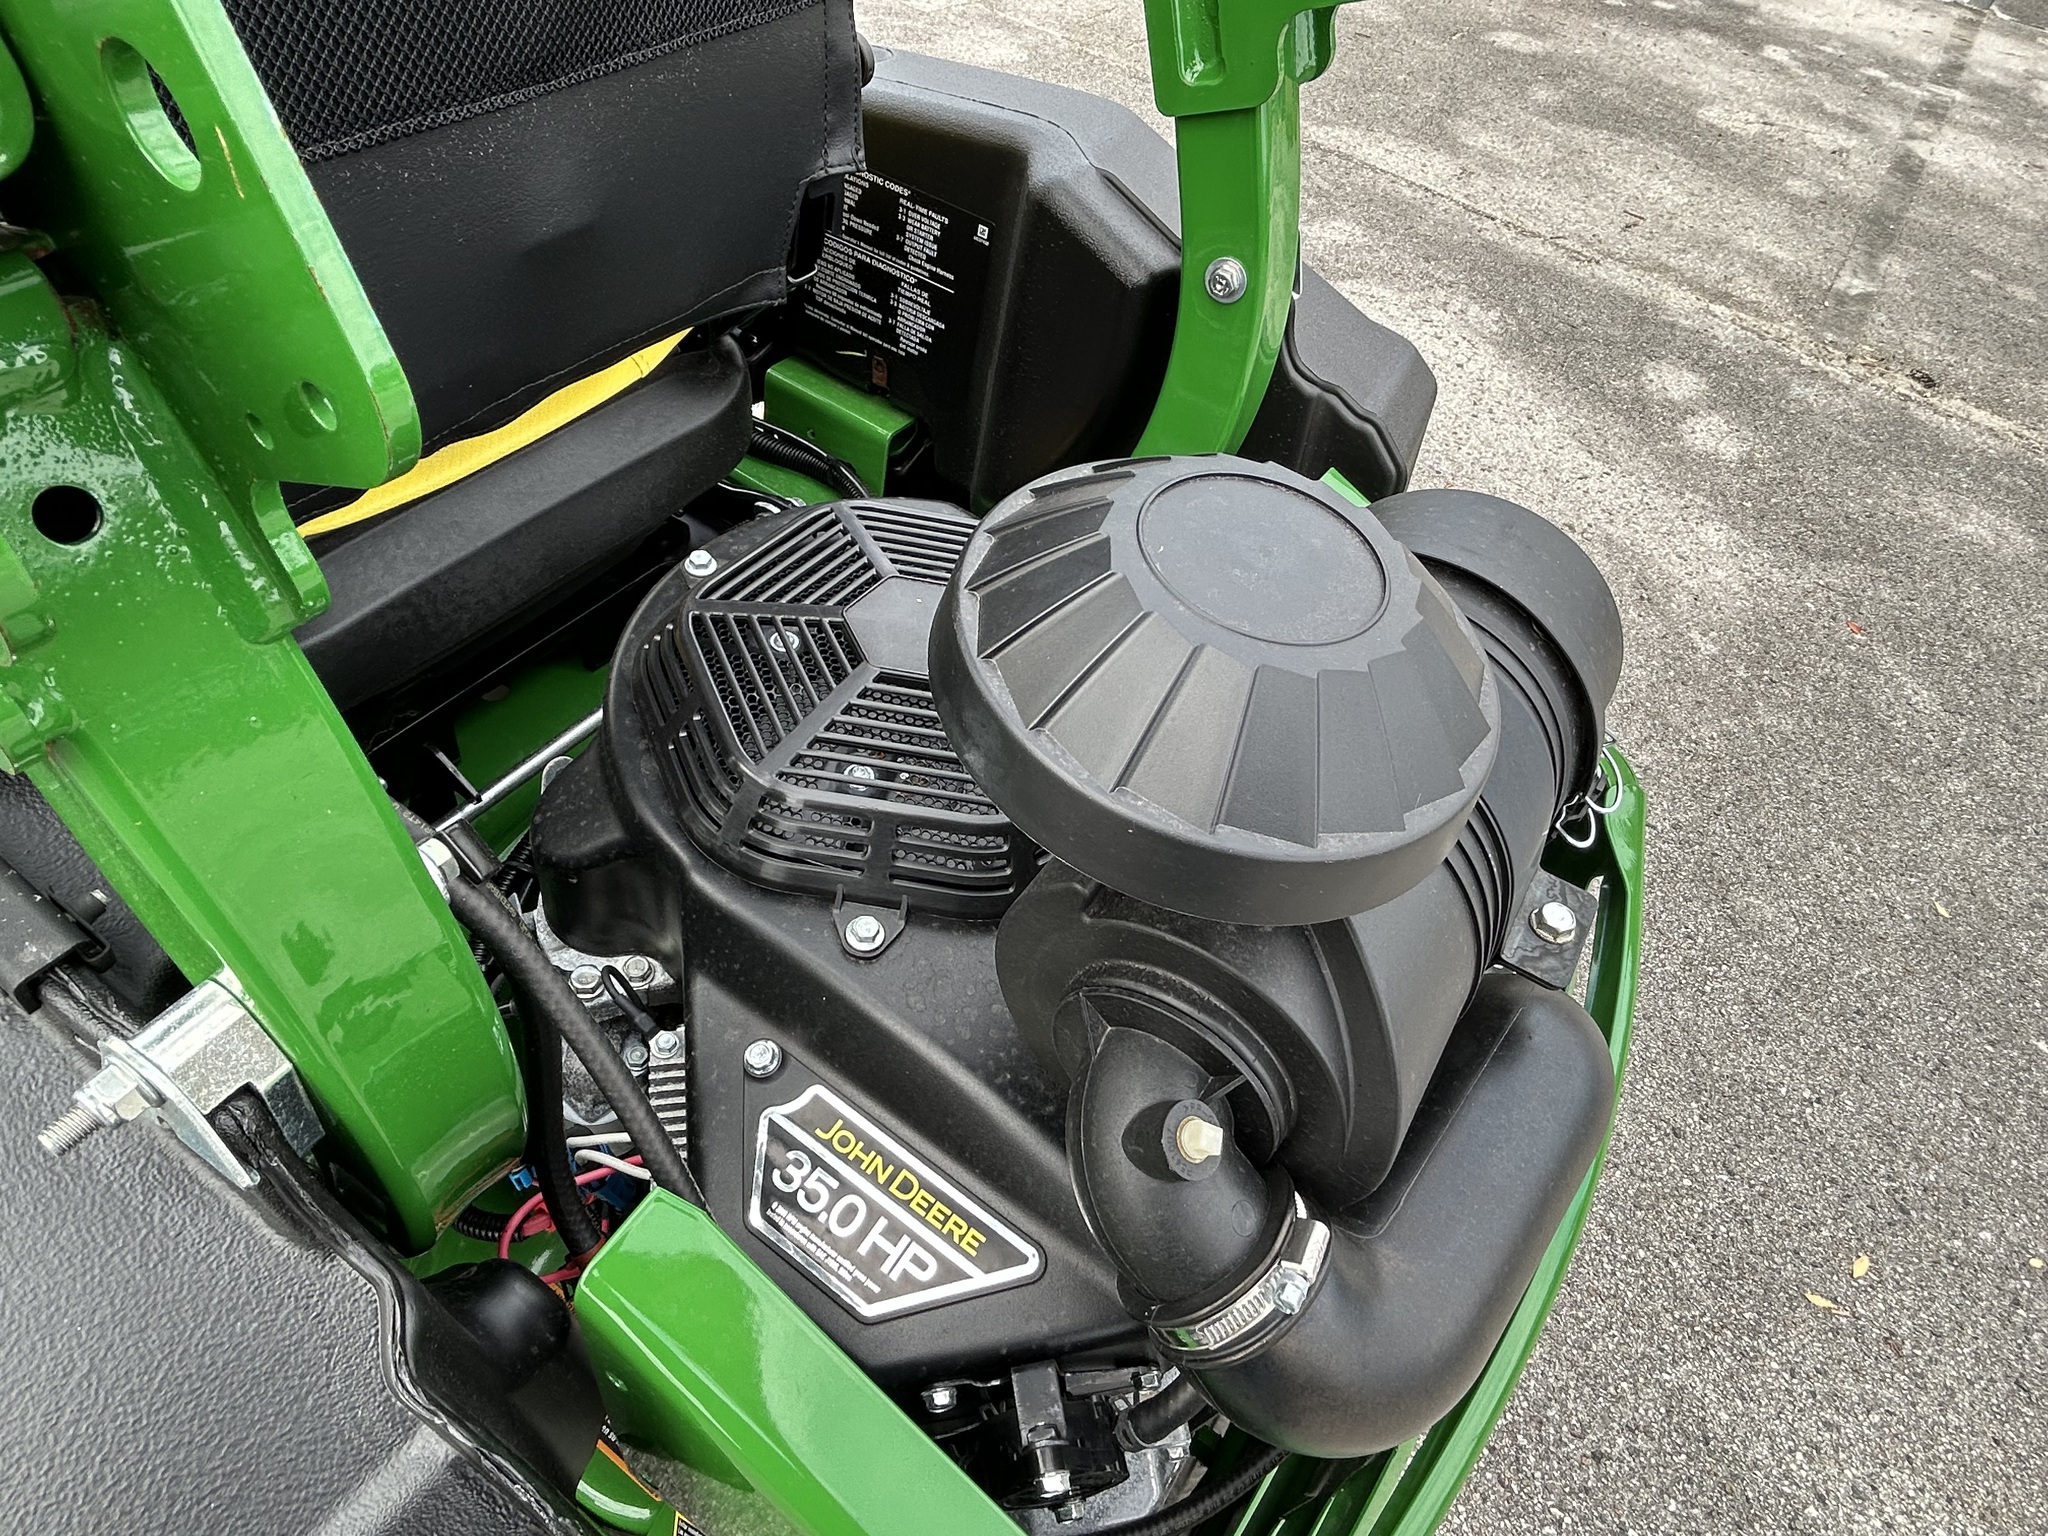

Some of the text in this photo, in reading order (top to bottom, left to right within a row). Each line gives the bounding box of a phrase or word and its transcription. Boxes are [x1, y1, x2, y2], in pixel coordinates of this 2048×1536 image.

[921, 216, 941, 230] VOLTAGE
[928, 210, 949, 225] FAULTS
[905, 231, 924, 244] SYSTEM
[914, 227, 934, 242] STARTER
[921, 223, 941, 237] BATTERY
[905, 238, 923, 251] OUTPUT
[853, 250, 871, 264] PARA
[904, 245, 927, 260] DETECTED
[897, 286, 931, 308] TIEMPO REAL
[901, 281, 929, 299] FALLAS DE
[814, 1118, 895, 1186] JOHN
[888, 1168, 987, 1258] DEERE
[771, 1149, 867, 1239] 35.0
[856, 1215, 938, 1283] HP
